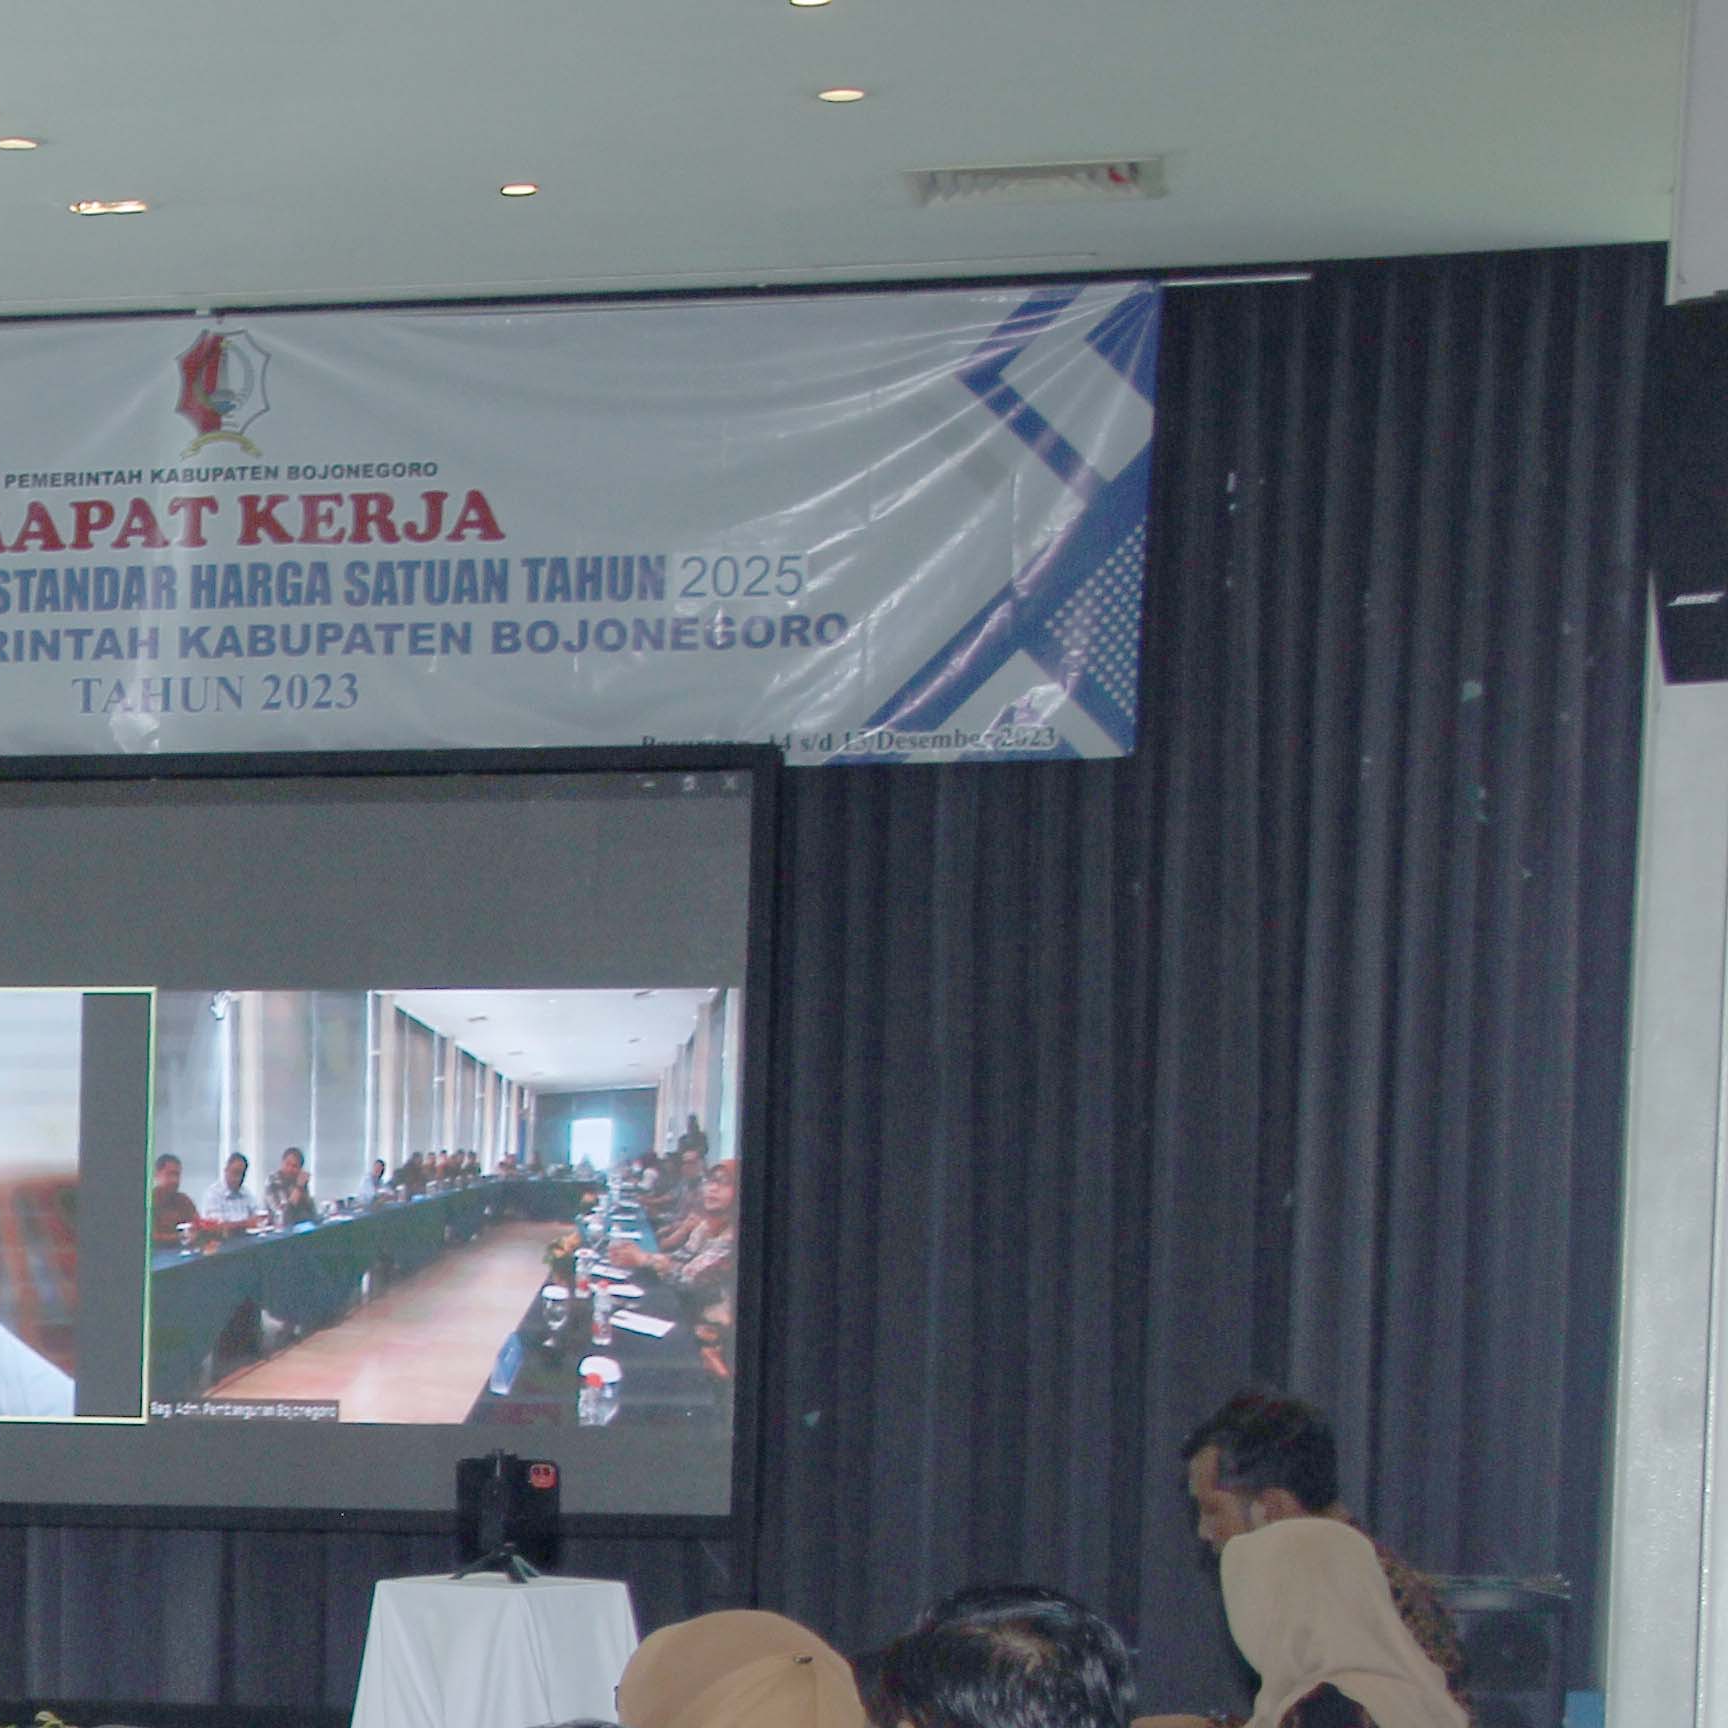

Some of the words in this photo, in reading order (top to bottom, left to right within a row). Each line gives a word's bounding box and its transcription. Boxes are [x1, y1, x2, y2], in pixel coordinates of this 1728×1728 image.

[4, 468, 143, 489] PEMERINTAH
[150, 465, 279, 484] KABUPATEN
[287, 461, 438, 481] BOJONEGORO
[236, 489, 505, 546] KERJA
[190, 562, 332, 611] HARGA
[343, 557, 509, 607] SATUAN
[521, 554, 668, 605] TAHUN
[680, 554, 804, 599] 2025
[179, 620, 472, 659] KABUPATEN
[492, 611, 847, 656] BOJONEGORO
[72, 676, 245, 715] TAHUN
[260, 672, 359, 711] 2023
